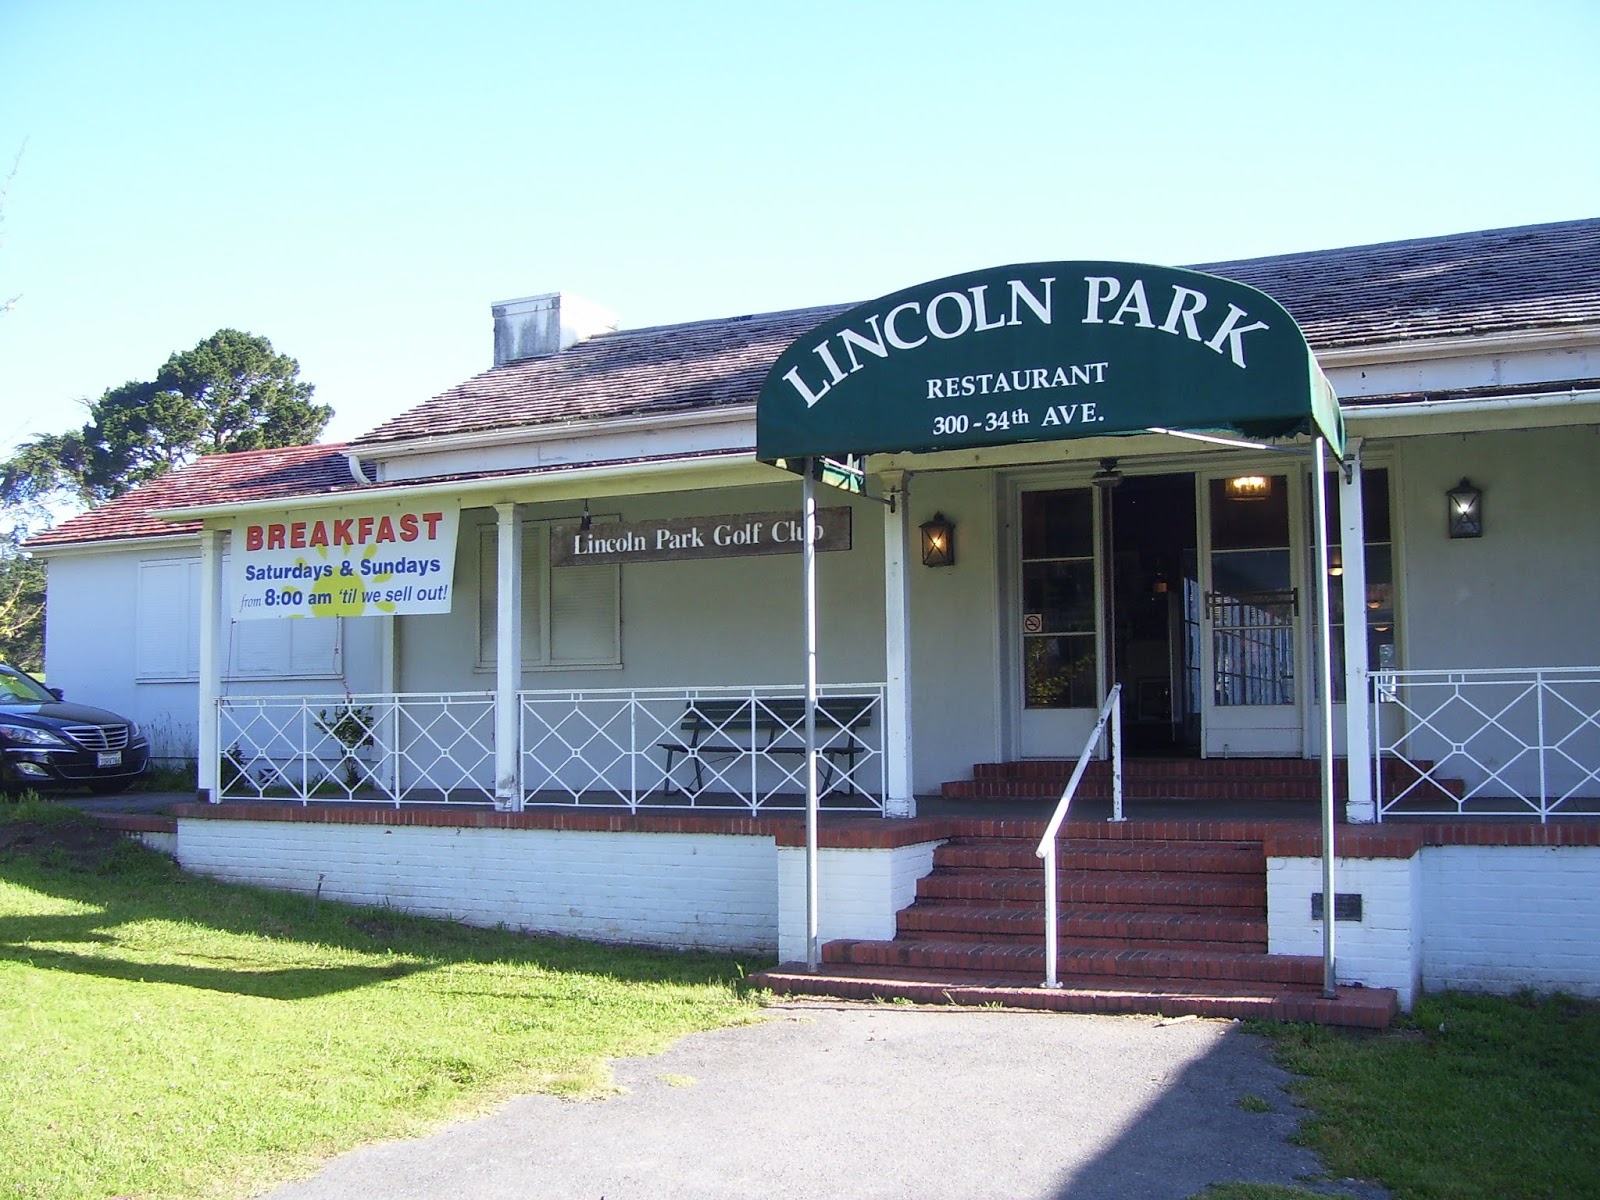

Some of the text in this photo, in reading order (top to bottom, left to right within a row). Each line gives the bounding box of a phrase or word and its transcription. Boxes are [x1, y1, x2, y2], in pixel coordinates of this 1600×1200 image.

[782, 276, 1270, 408] LINCOLN PARK
[926, 361, 1109, 400] RESTAURANT
[1041, 401, 1105, 427] AVE.
[246, 512, 443, 551] BREAKFAST
[574, 532, 646, 555] Lincoln
[656, 527, 705, 550] Park
[713, 522, 763, 546] Golf
[245, 556, 441, 581] Saturdays & Sundays
[239, 594, 262, 613] from
[264, 589, 303, 606] 8:00
[308, 592, 332, 604] am
[361, 590, 381, 602] we
[385, 586, 413, 602] sell
[417, 584, 448, 601] out!
